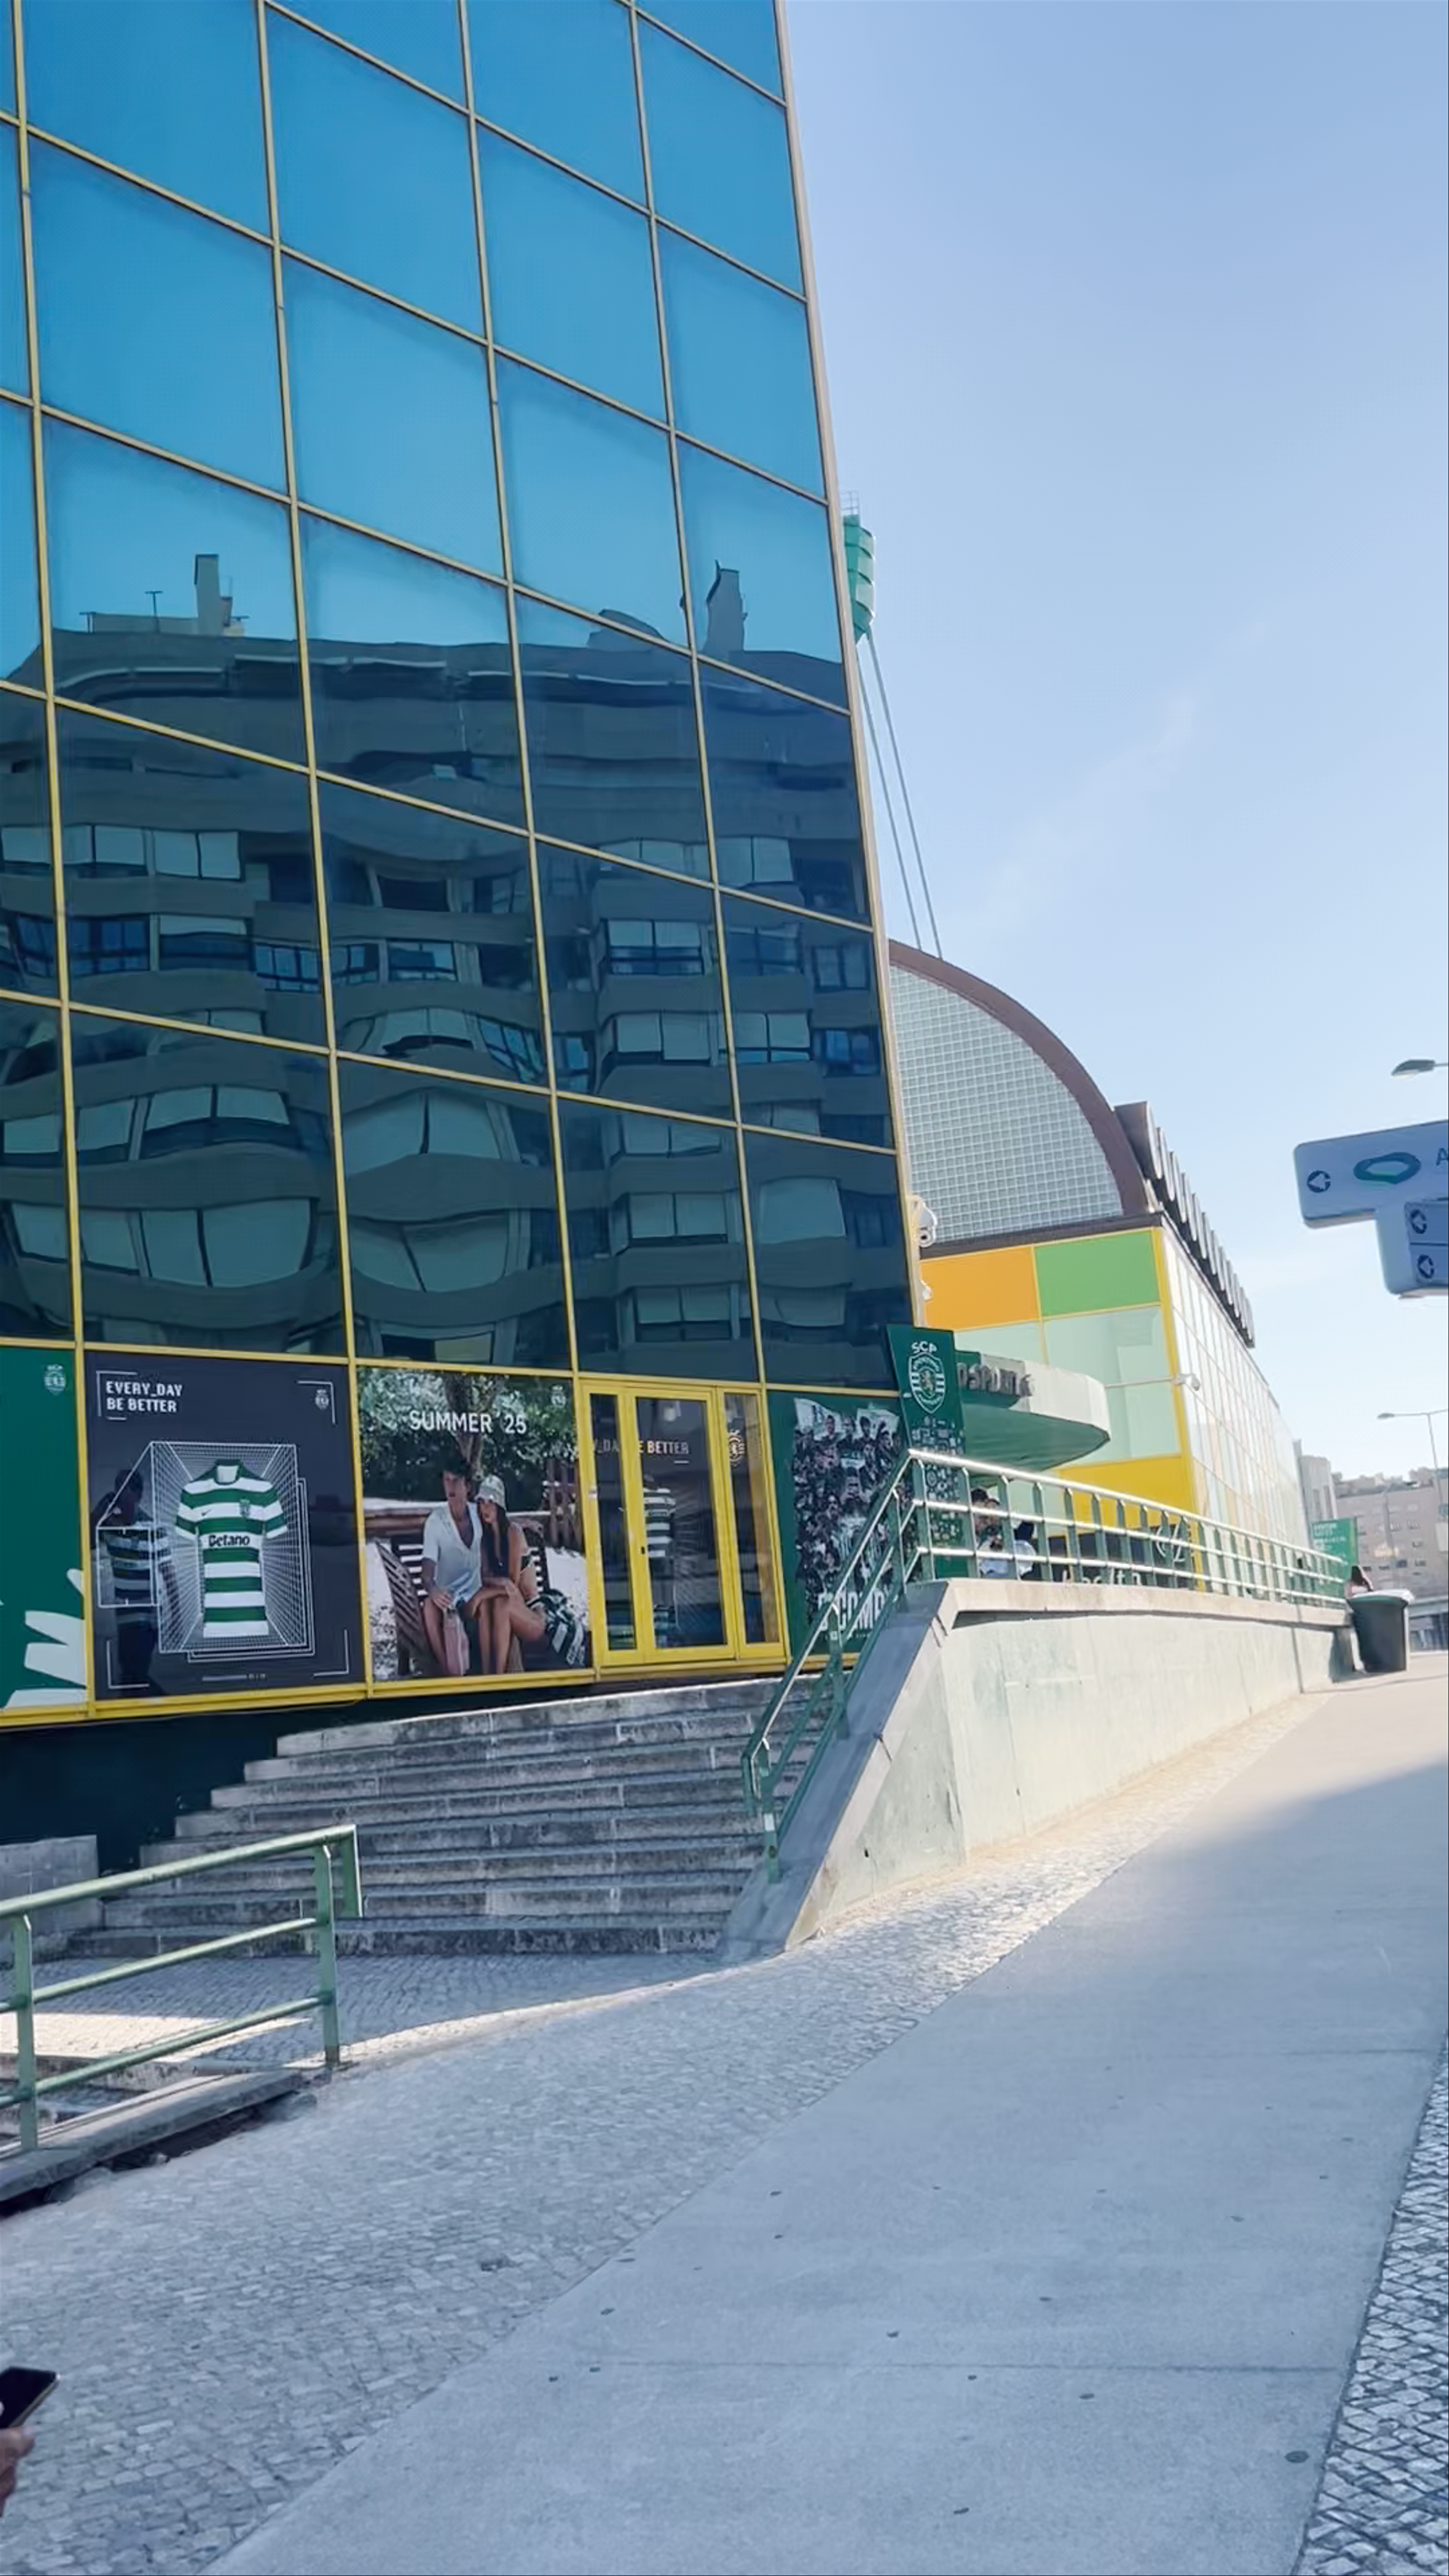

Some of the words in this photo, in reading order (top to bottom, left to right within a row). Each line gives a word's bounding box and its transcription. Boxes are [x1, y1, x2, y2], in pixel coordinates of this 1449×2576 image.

[911, 1341, 937, 1354] SCP
[106, 1381, 183, 1397] EVERY_DAY
[107, 1397, 124, 1411] BE
[128, 1398, 177, 1413] BETTER
[409, 1409, 492, 1433] SUMMER
[647, 1440, 689, 1454] BETTER
